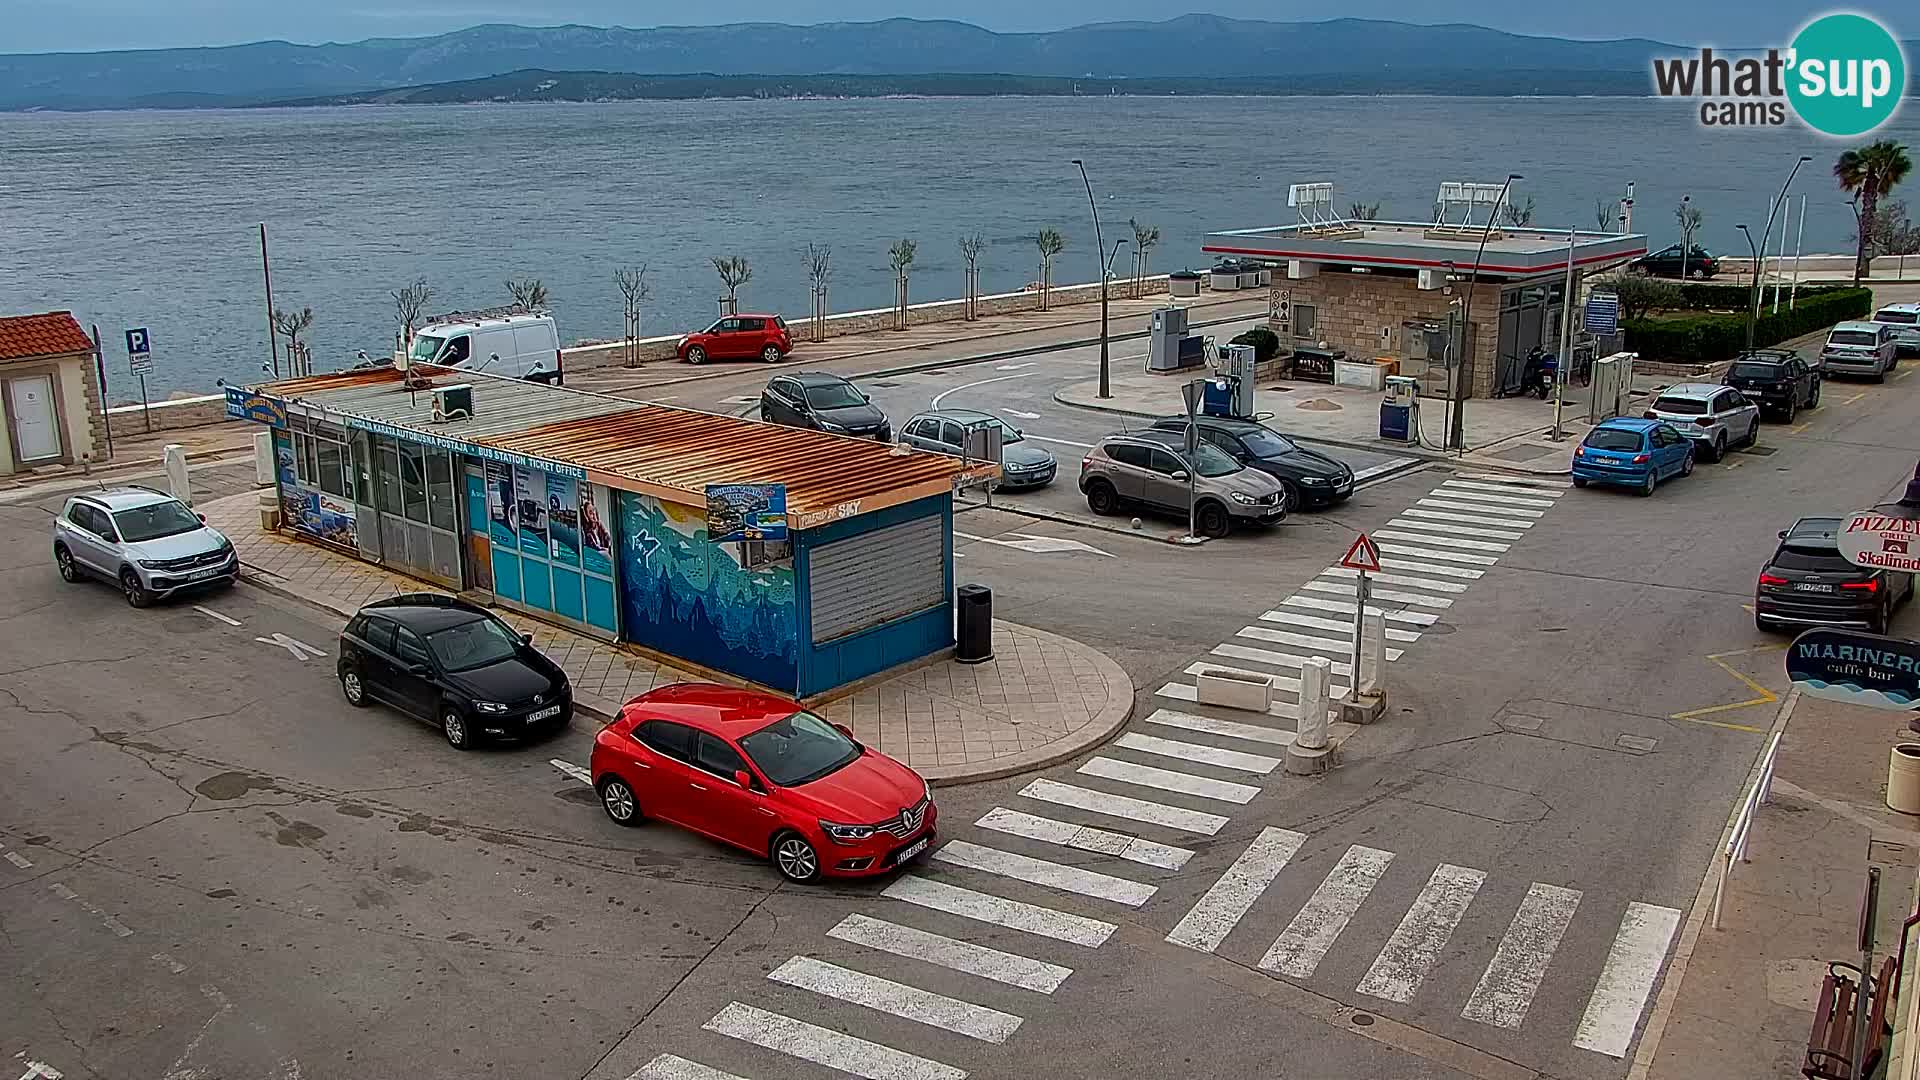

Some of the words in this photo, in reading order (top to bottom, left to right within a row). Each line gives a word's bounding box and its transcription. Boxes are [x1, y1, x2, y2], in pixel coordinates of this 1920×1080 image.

[131, 332, 143, 350] P
[373, 423, 397, 436] KARATA
[397, 428, 437, 446] AUTOBUSNA
[437, 437, 469, 453] POSTAJA
[478, 447, 493, 459] BUS
[494, 450, 526, 465] STATION
[529, 458, 554, 472] TICKET
[556, 464, 582, 478] OFFICE
[1880, 531, 1916, 542] GRILL
[1827, 663, 1863, 676] caffe
[1868, 667, 1895, 681] bar
